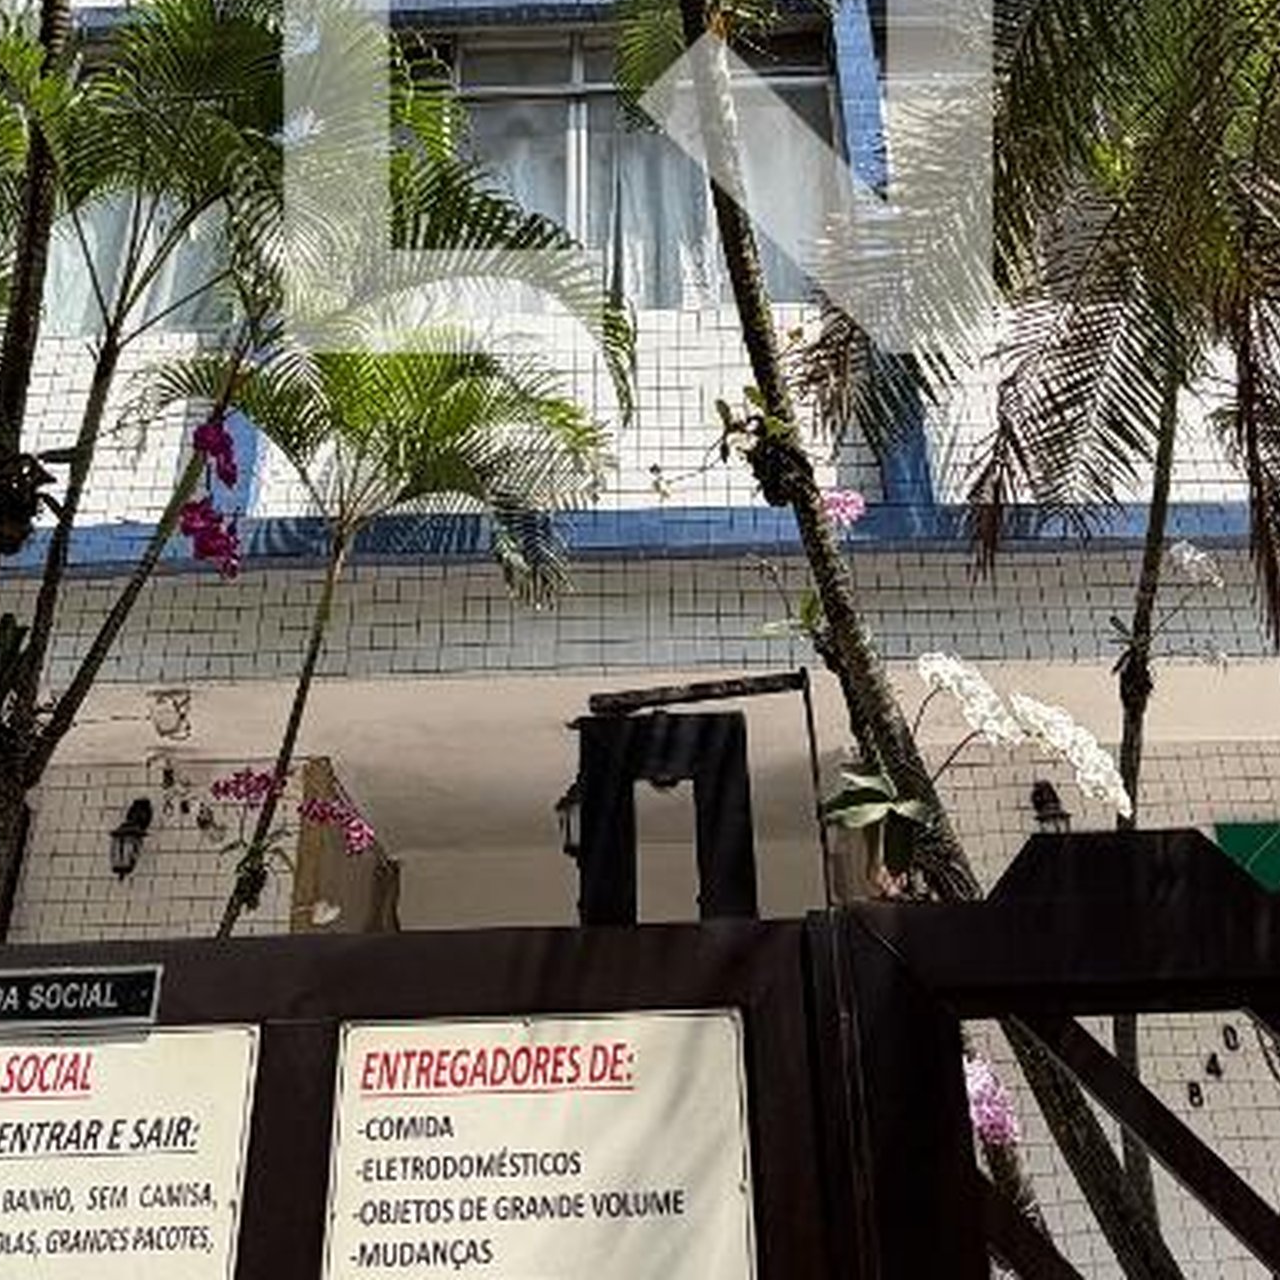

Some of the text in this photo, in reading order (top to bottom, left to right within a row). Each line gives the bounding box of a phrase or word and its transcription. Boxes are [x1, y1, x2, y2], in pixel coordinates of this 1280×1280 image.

[27, 983, 118, 1010] SOCIAL
[0, 1052, 93, 1093] SOCIAL
[360, 1042, 635, 1091] ENTREGADORES DE:
[107, 1118, 123, 1151] E
[130, 1116, 199, 1149] SAIR:
[357, 1116, 455, 1141] -COMIDA
[357, 1147, 582, 1182] -ELETRODOMÉSTICOS
[2, 1186, 75, 1213] BANHO,
[86, 1185, 129, 1211] SEM
[139, 1182, 218, 1210] CAMISA,
[352, 1190, 685, 1227] -OBJETOS DE GRANDE VOLUME
[46, 1227, 130, 1254] GRANDES
[131, 1225, 214, 1254] PACOTES,
[349, 1239, 494, 1271] -MUDANÇAS
